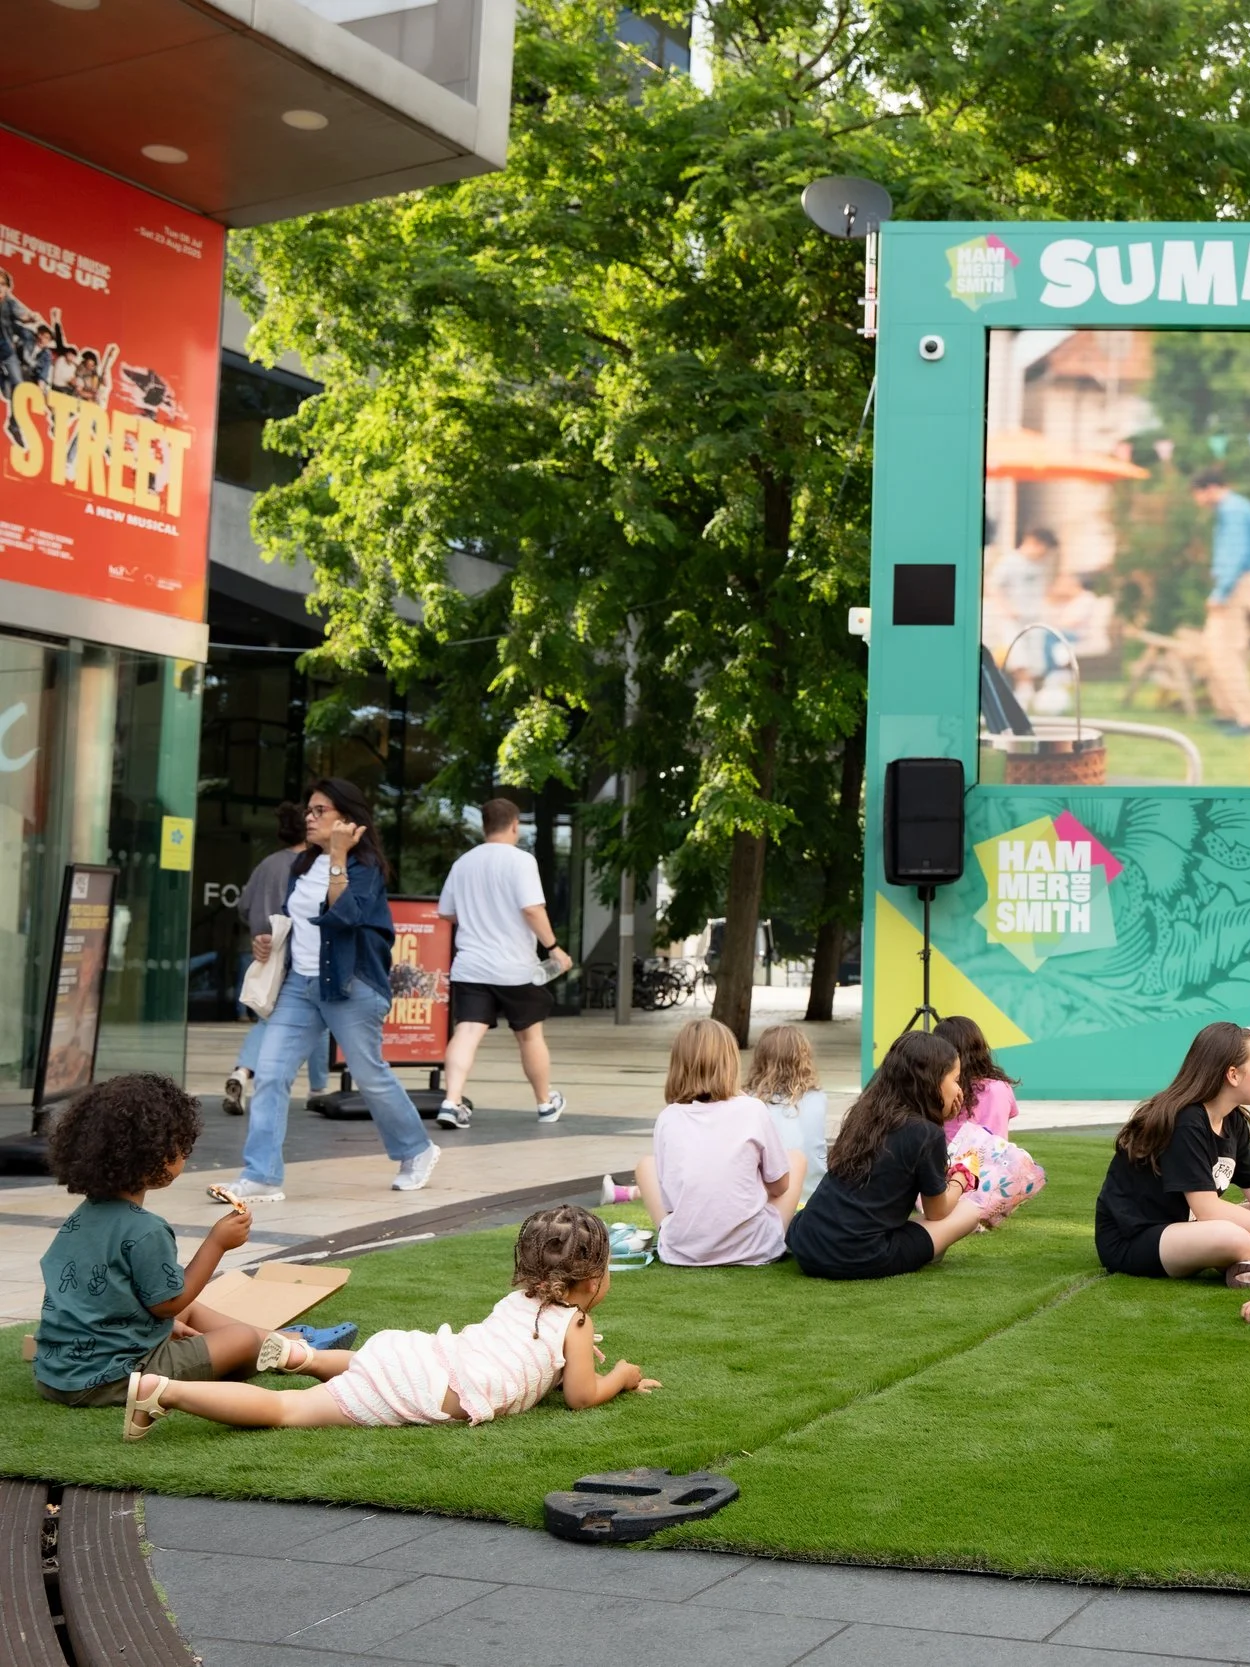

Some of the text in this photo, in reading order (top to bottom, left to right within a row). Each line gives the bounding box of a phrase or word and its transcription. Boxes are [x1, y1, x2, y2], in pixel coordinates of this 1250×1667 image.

[957, 247, 1005, 262] HAM
[39, 255, 72, 280] US
[75, 269, 110, 295] UP.
[957, 263, 993, 277] MER
[957, 278, 1004, 293] SMITH
[10, 381, 192, 518] STREET
[84, 502, 180, 537] A NEW MUSICAL
[998, 840, 1091, 872] HAM
[203, 882, 247, 909] FO
[998, 873, 1070, 900] MER
[1070, 873, 1091, 903] BID
[996, 901, 1091, 933] SMITH
[383, 996, 433, 1025] TREET
